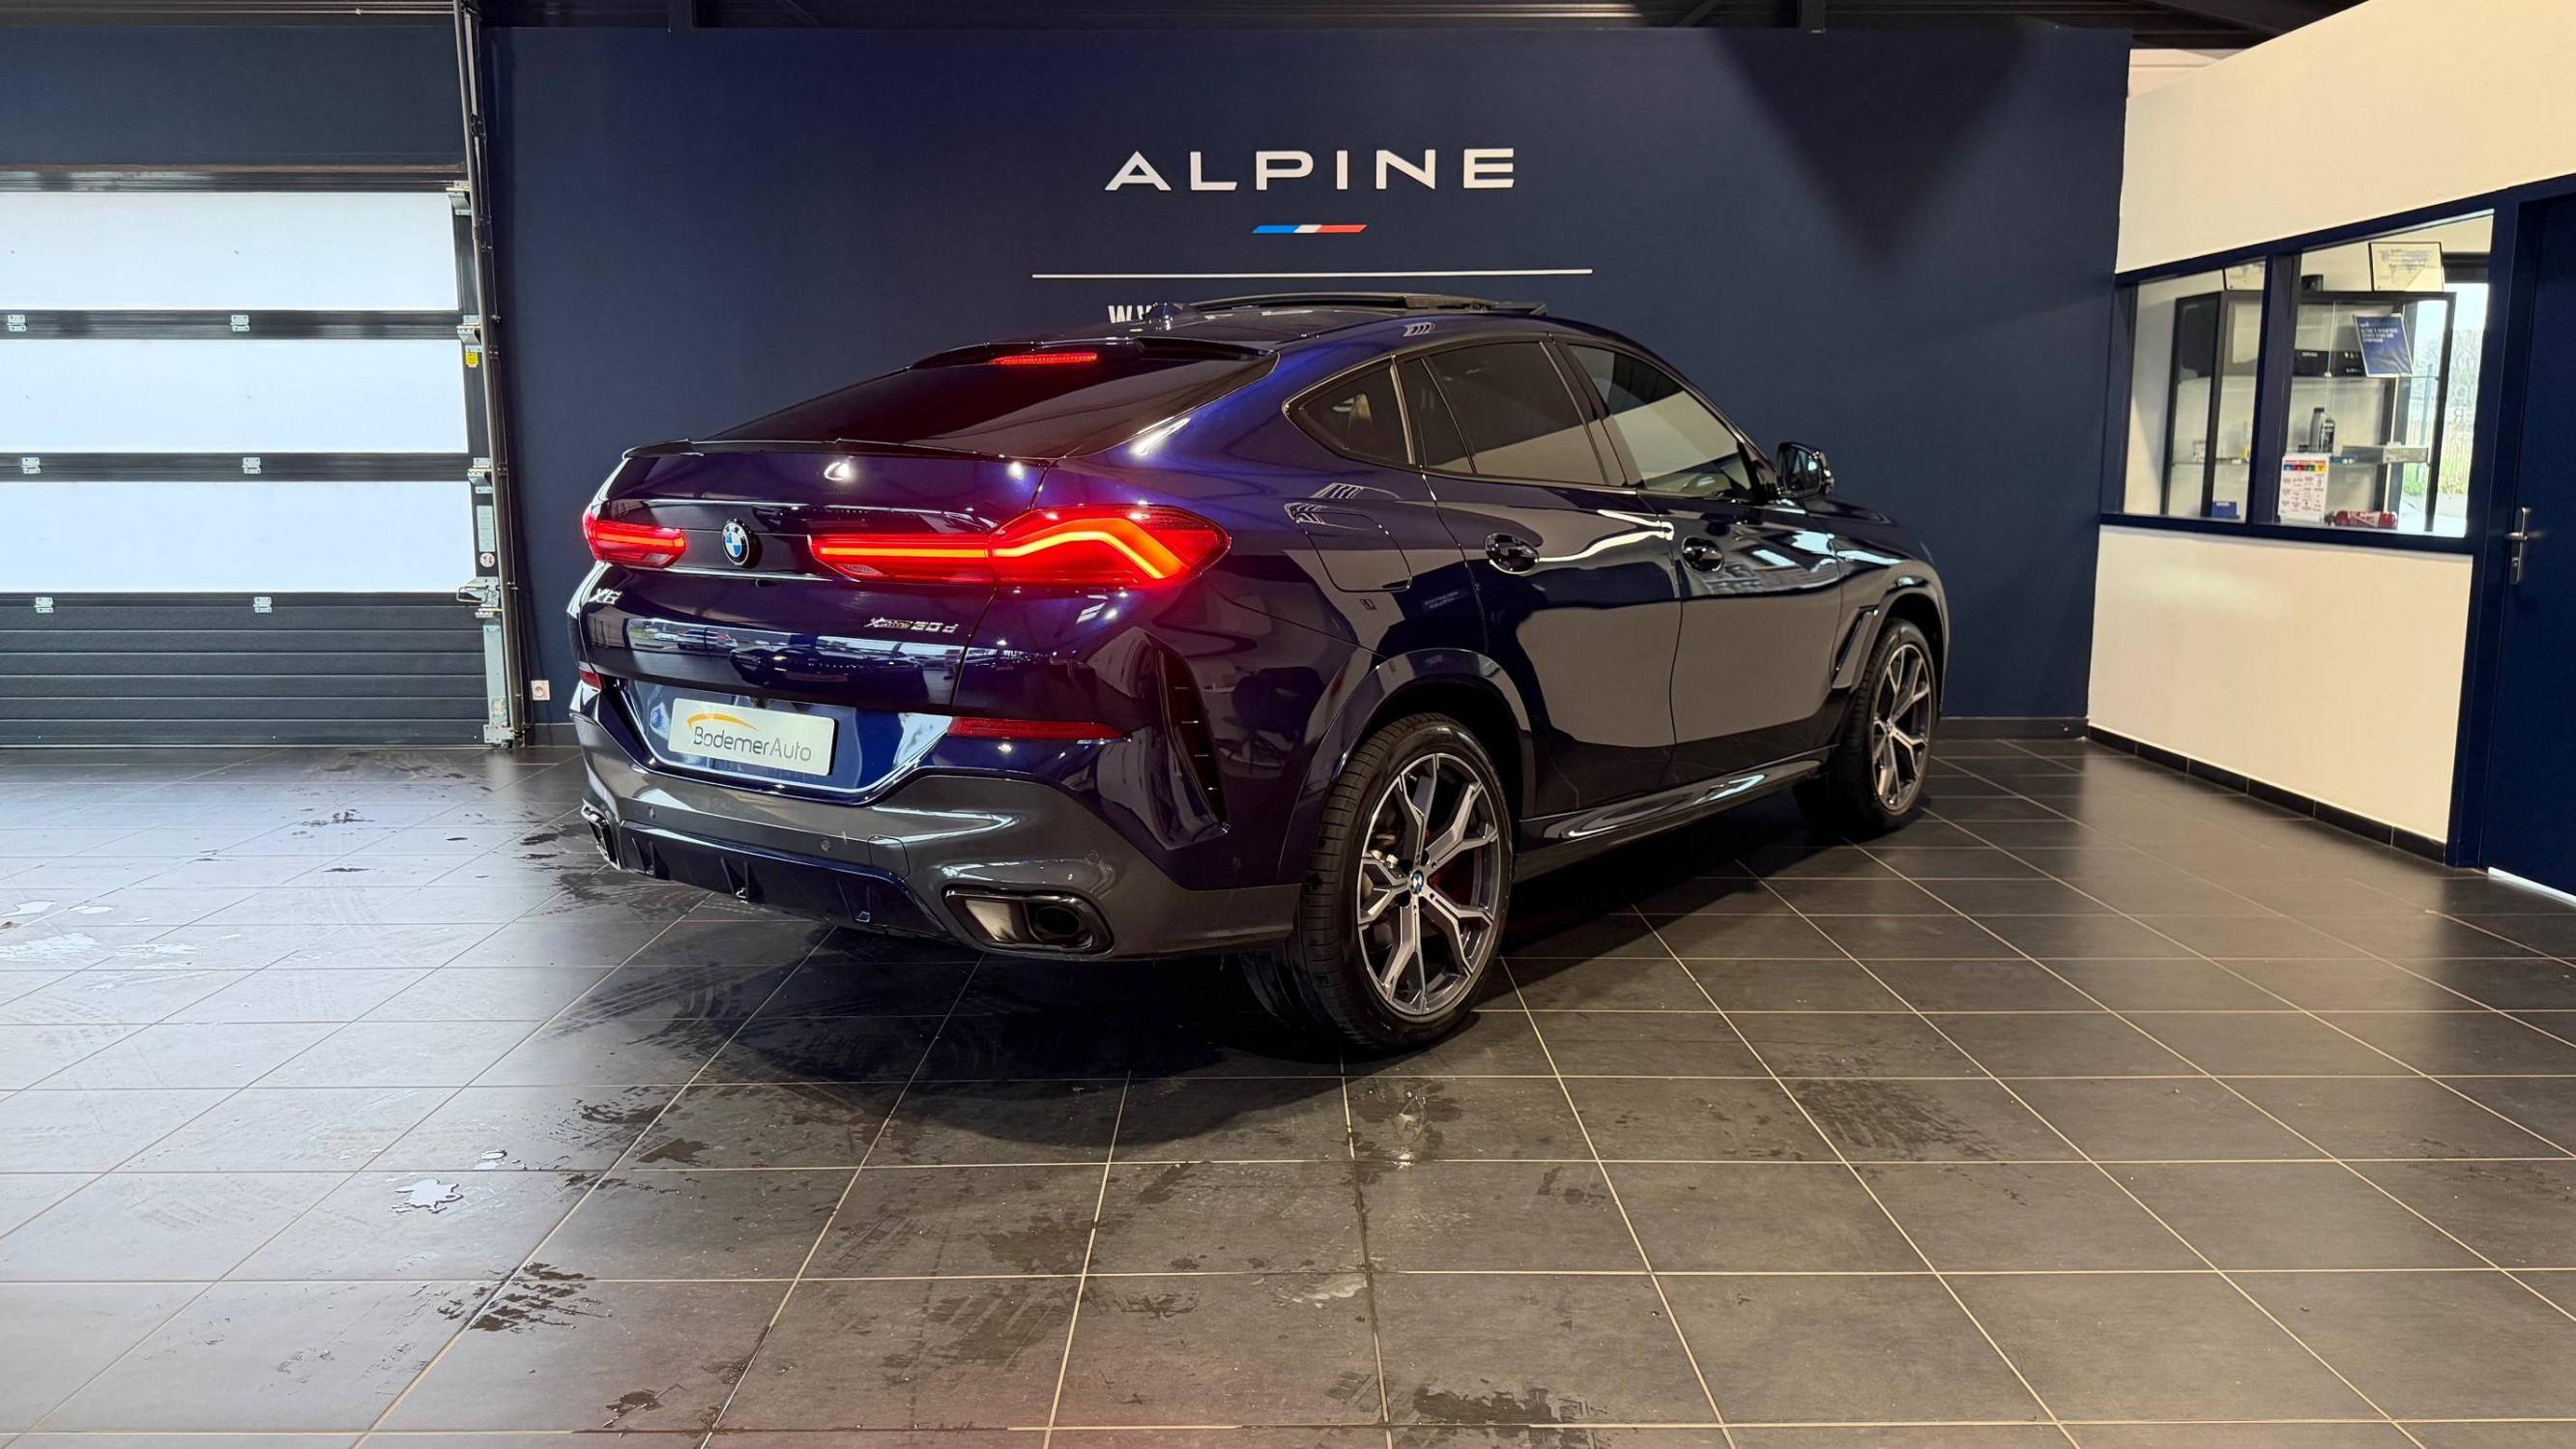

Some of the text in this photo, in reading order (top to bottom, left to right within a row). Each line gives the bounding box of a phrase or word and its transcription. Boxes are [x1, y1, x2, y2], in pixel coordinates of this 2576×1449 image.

[1105, 148, 1514, 191] ALPINE
[588, 588, 623, 605] X6
[693, 726, 812, 762] BodemerAuto
